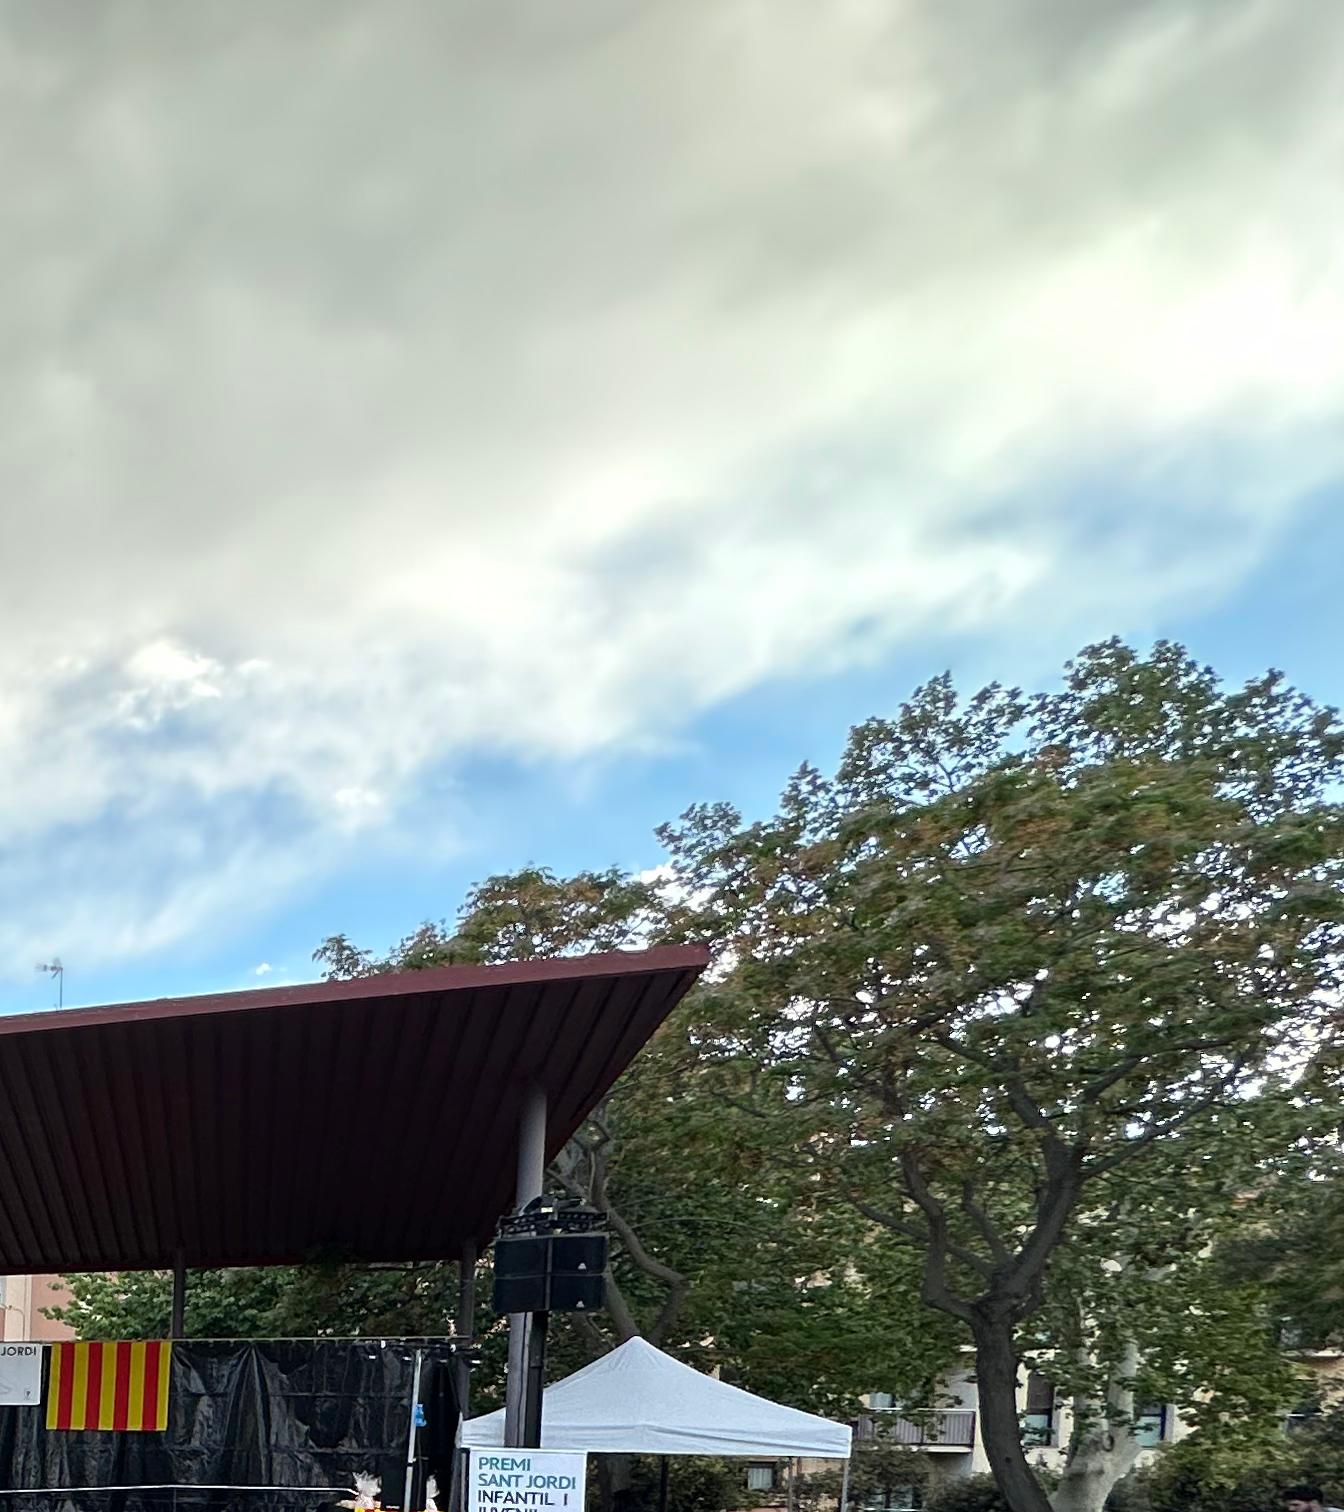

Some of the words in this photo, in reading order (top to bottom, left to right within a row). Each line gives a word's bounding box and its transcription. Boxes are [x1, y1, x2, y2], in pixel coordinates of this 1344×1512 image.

[1, 1346, 37, 1357] JORDI
[478, 1457, 531, 1471] PREMI
[478, 1473, 524, 1488] SANT
[526, 1475, 576, 1489] JORDI
[478, 1490, 555, 1506] INFANTIL
[563, 1493, 568, 1506] I
